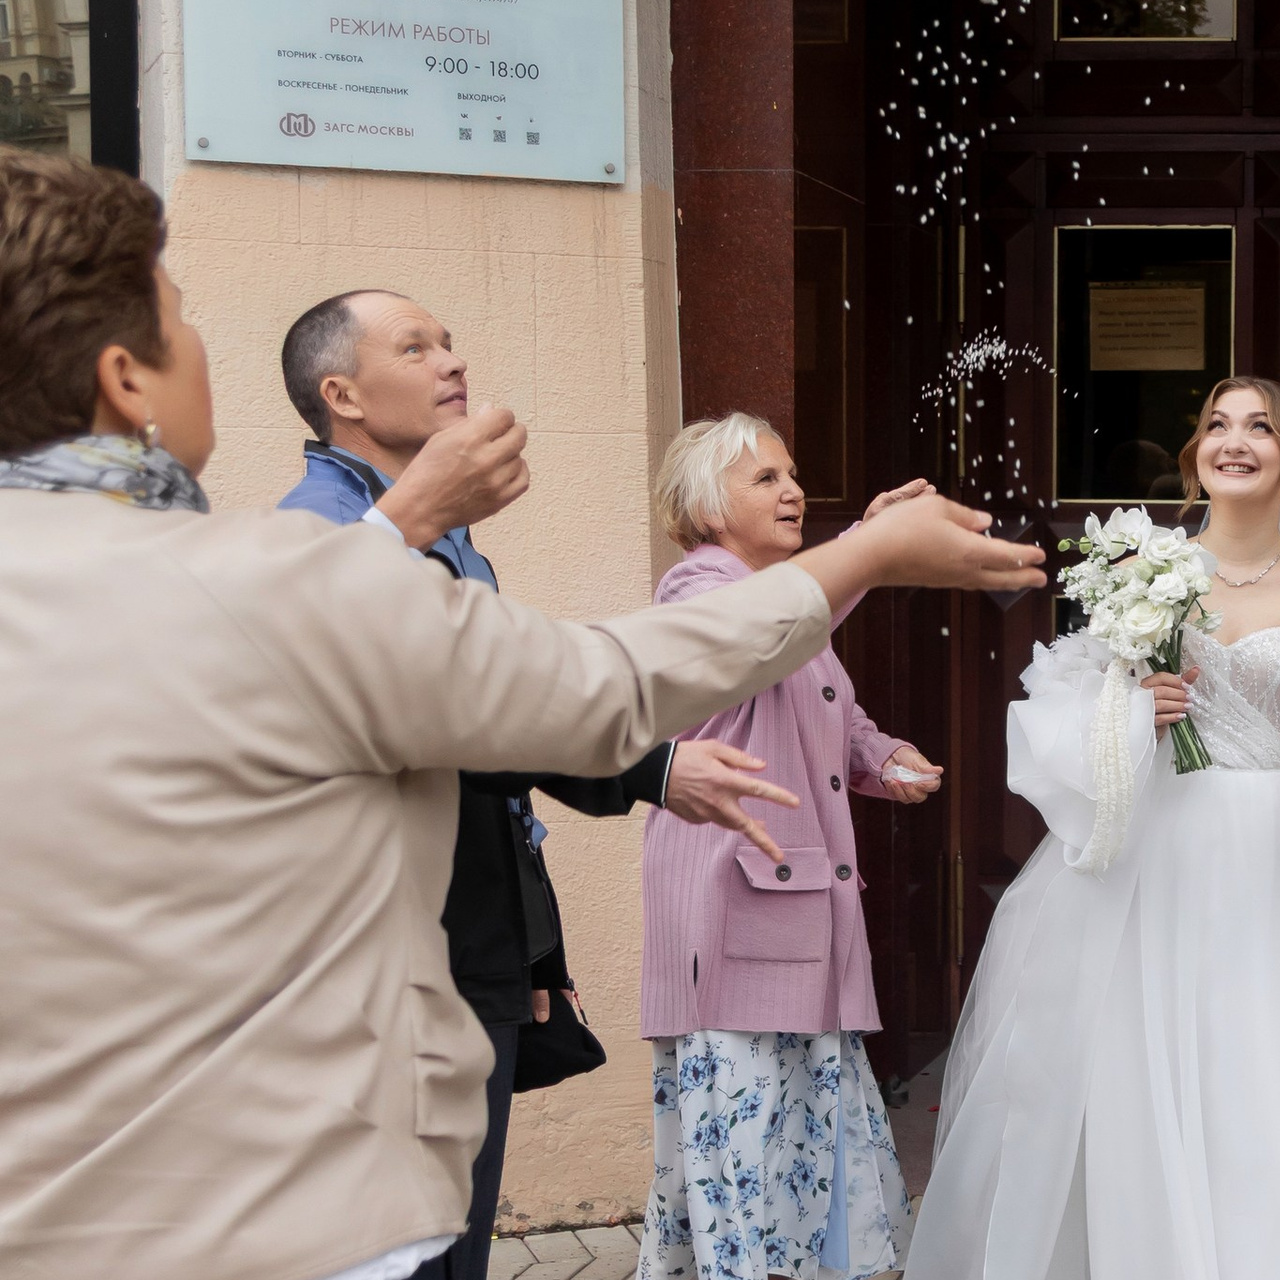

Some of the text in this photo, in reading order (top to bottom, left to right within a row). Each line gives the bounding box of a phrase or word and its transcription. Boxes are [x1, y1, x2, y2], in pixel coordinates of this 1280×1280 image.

[330, 16, 491, 46] РЕЖИМ РАБОТЫ
[277, 50, 317, 60] ВТОРНИК
[324, 52, 364, 64] СУББОТА
[425, 55, 469, 75] 9:00
[488, 60, 540, 80] 18:00
[278, 79, 338, 91] ВОСКРЕСЕНЬЕ
[345, 84, 409, 96] ПОНЕДЕЛЬНИК
[457, 92, 506, 103] ВЫХОДНОЙ
[323, 122, 415, 137] ЗАГС МОСКВЫ
